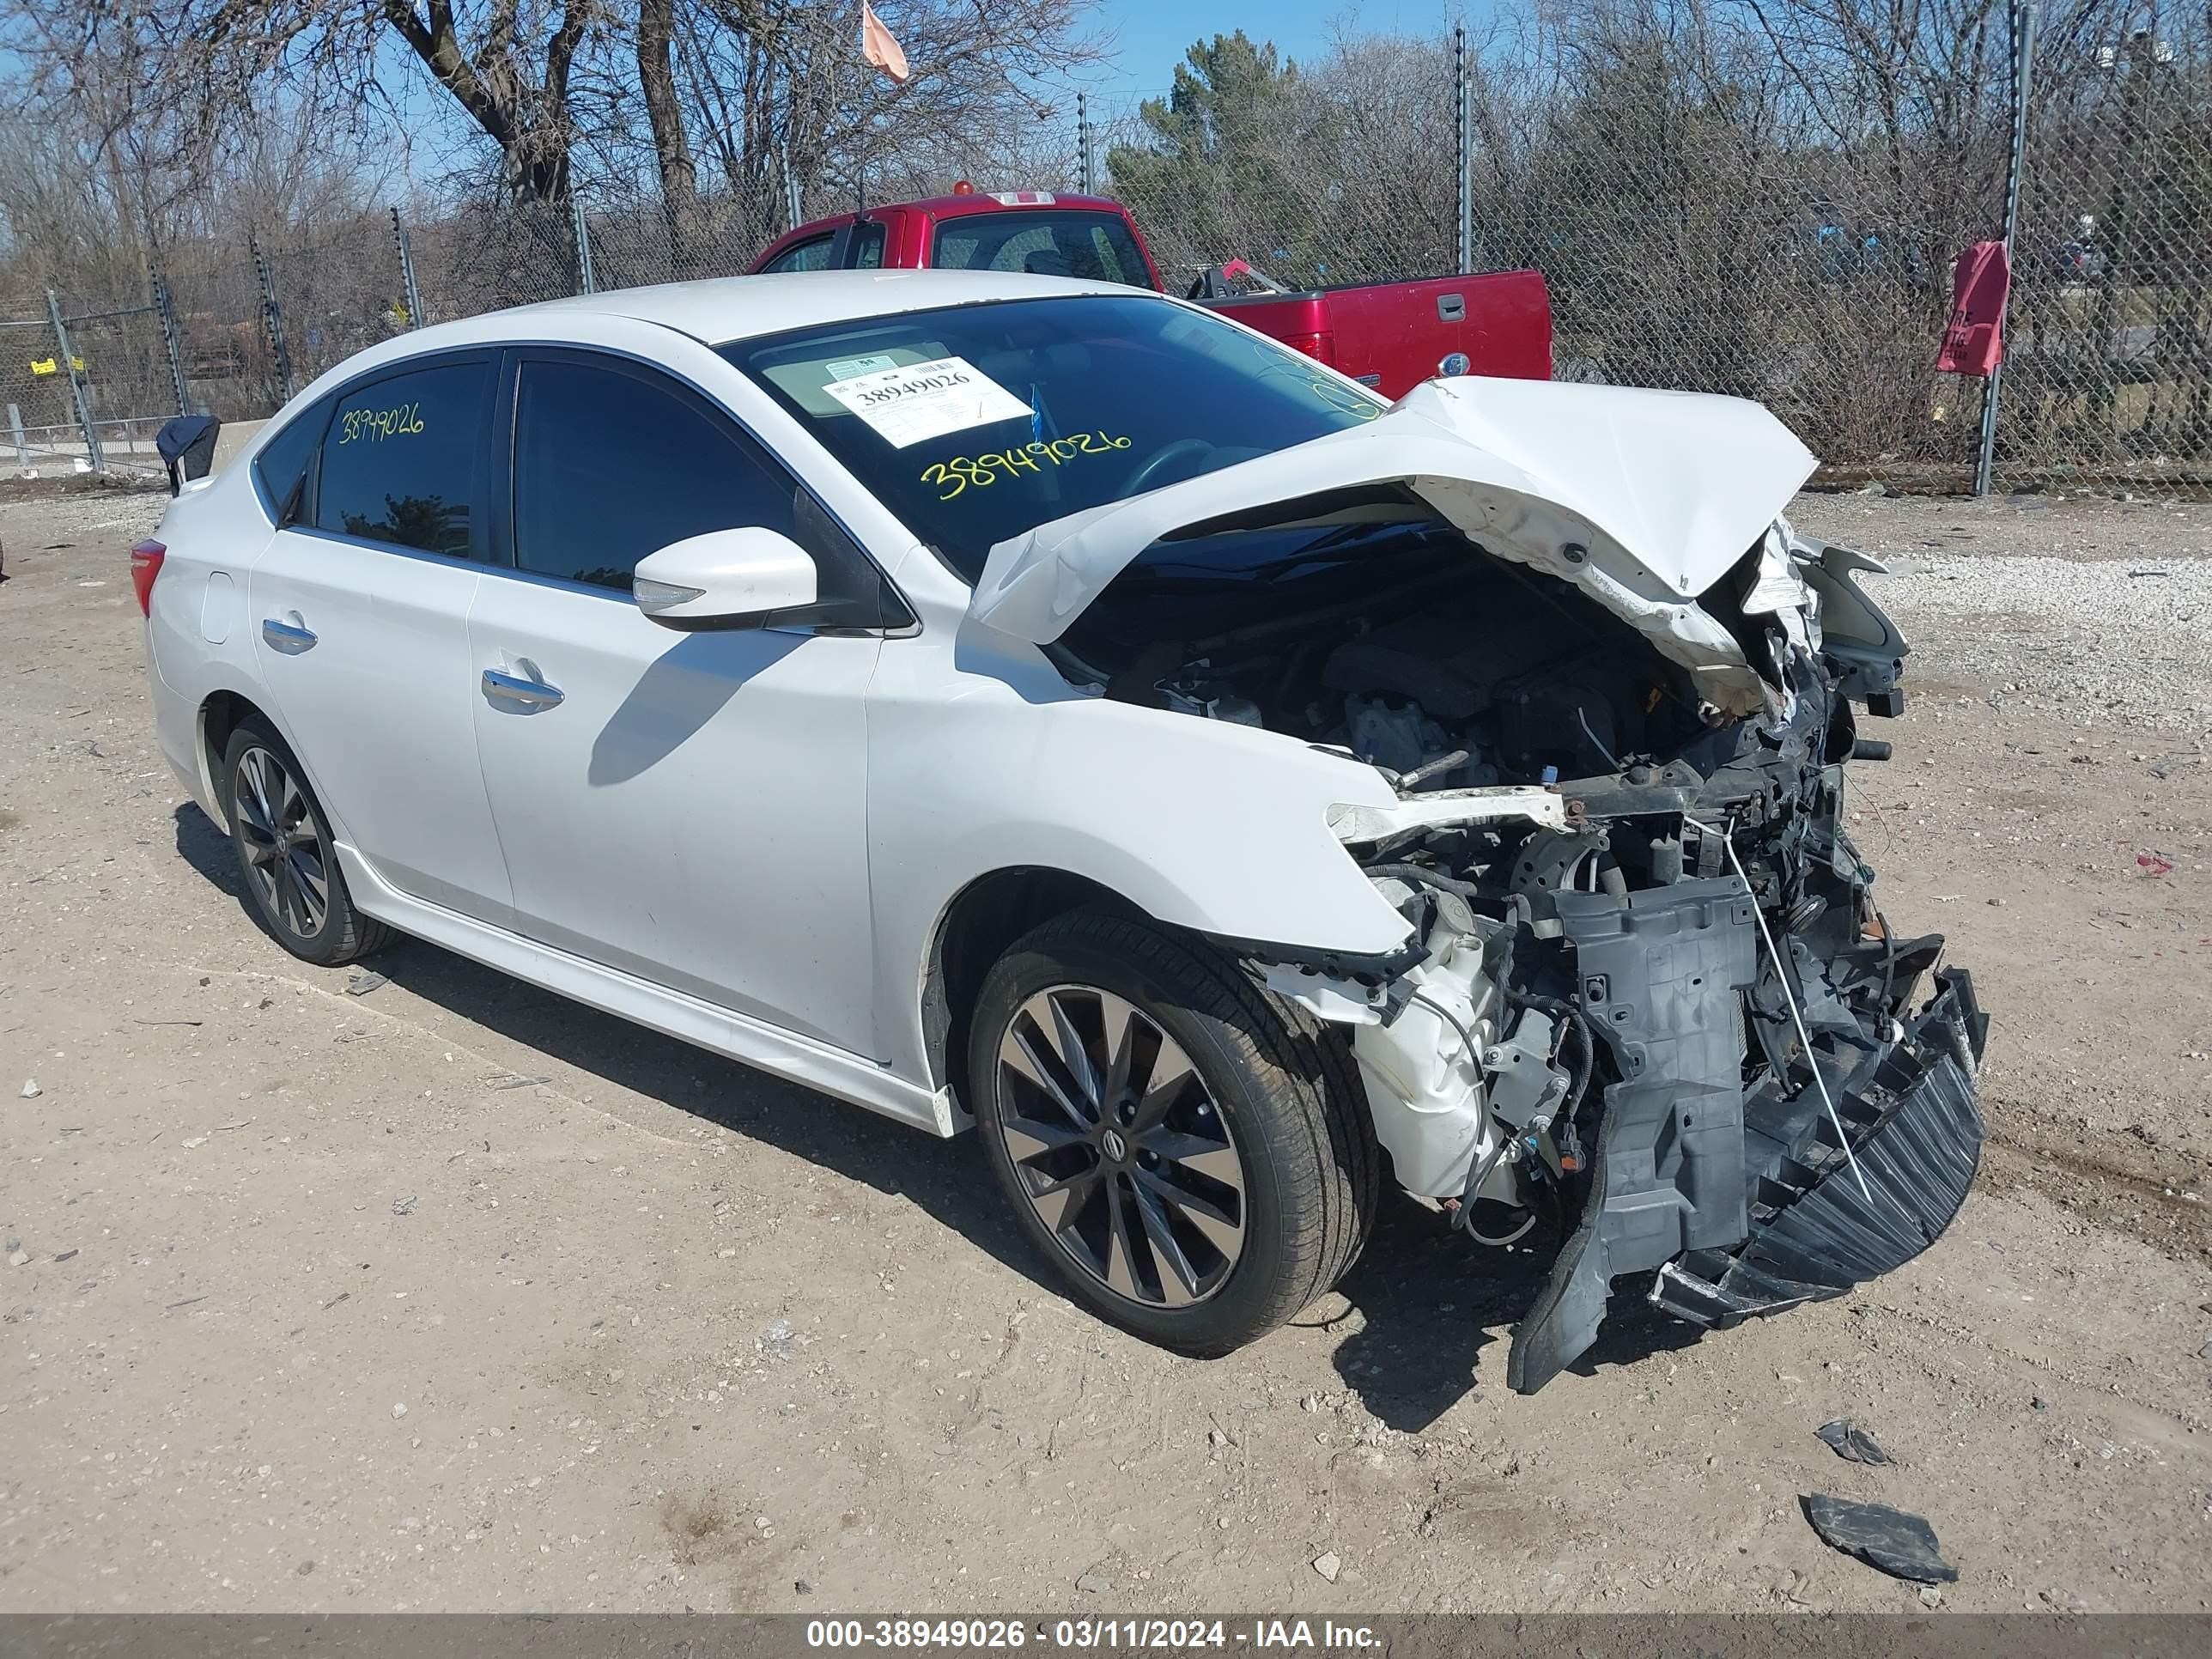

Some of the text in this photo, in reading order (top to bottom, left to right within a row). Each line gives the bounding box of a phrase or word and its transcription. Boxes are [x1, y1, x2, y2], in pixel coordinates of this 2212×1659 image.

[1954, 309, 1973, 328] RE
[856, 371, 970, 406] 38949026
[339, 401, 424, 445] 38949026
[920, 431, 1132, 501] 38949026
